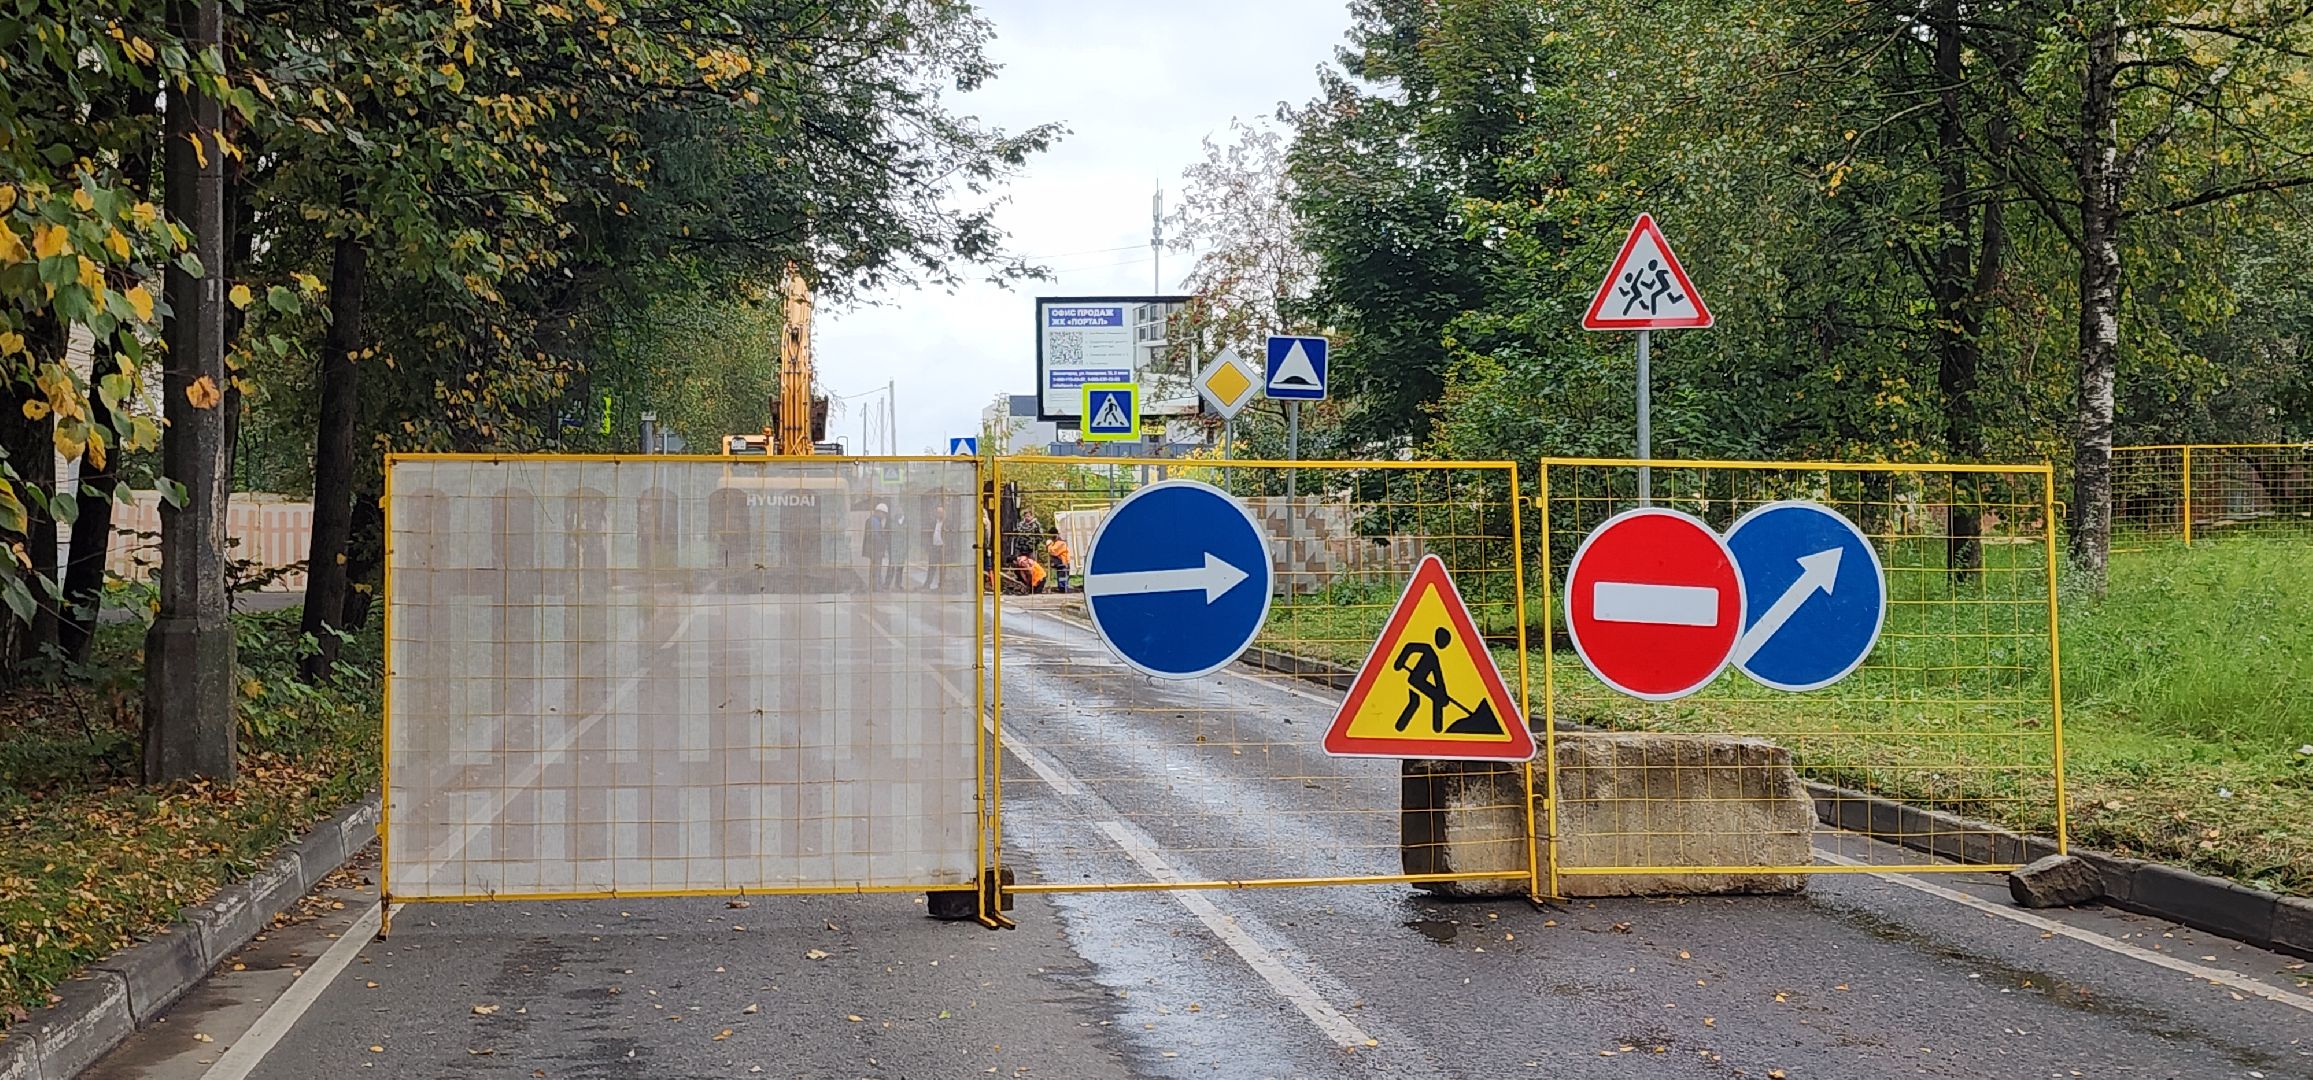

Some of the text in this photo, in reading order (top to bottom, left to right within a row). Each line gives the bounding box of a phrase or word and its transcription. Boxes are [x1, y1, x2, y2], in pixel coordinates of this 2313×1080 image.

[1052, 309, 1114, 317] ОФИС ПРОДАЖ
[1052, 318, 1108, 326] ЖК «ПОРТАЛ»
[746, 495, 815, 506] HYUNDAI
